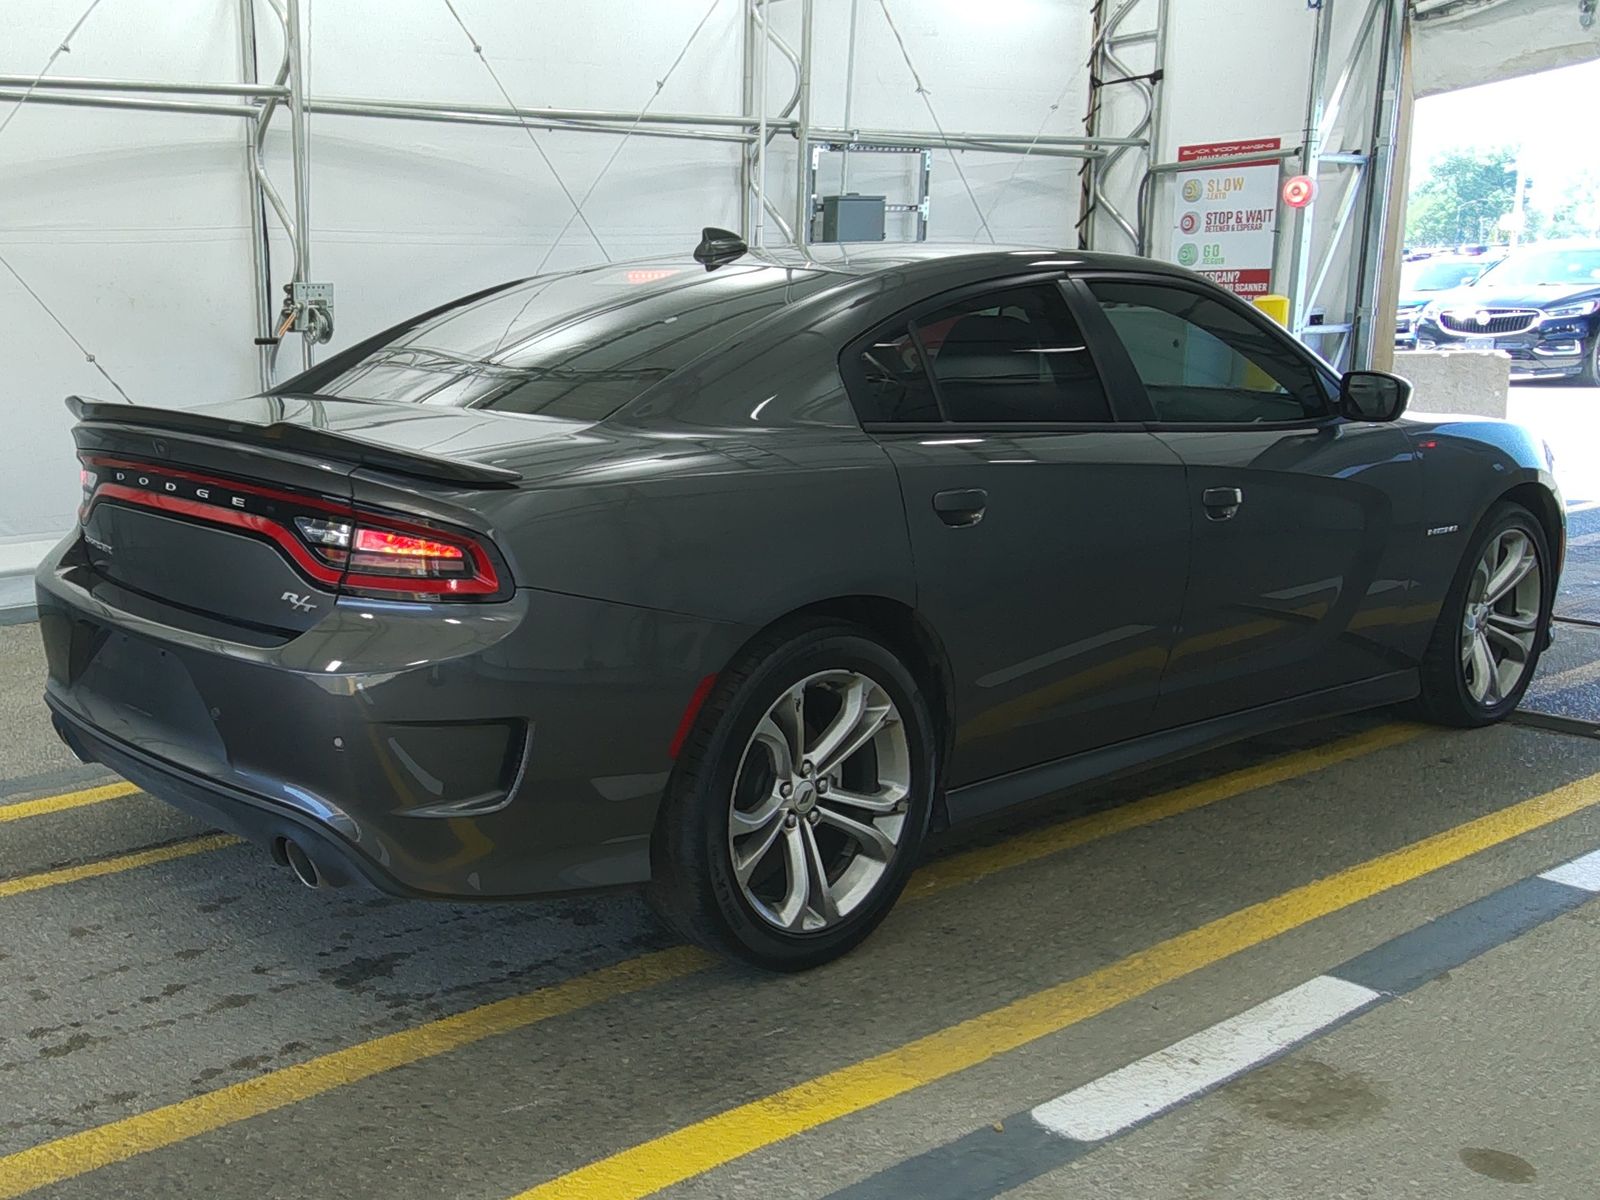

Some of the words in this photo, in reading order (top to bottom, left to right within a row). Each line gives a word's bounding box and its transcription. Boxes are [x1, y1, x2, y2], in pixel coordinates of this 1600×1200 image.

[1207, 177, 1244, 193] SLOW
[1205, 211, 1233, 225] STOP
[1235, 210, 1243, 224] &
[1246, 209, 1274, 223] WAIT
[1204, 224, 1231, 232] DETENER
[1203, 244, 1220, 257] GO
[1235, 282, 1268, 292] SCANNER
[116, 472, 246, 507] DODGE
[280, 591, 318, 613] R/T
